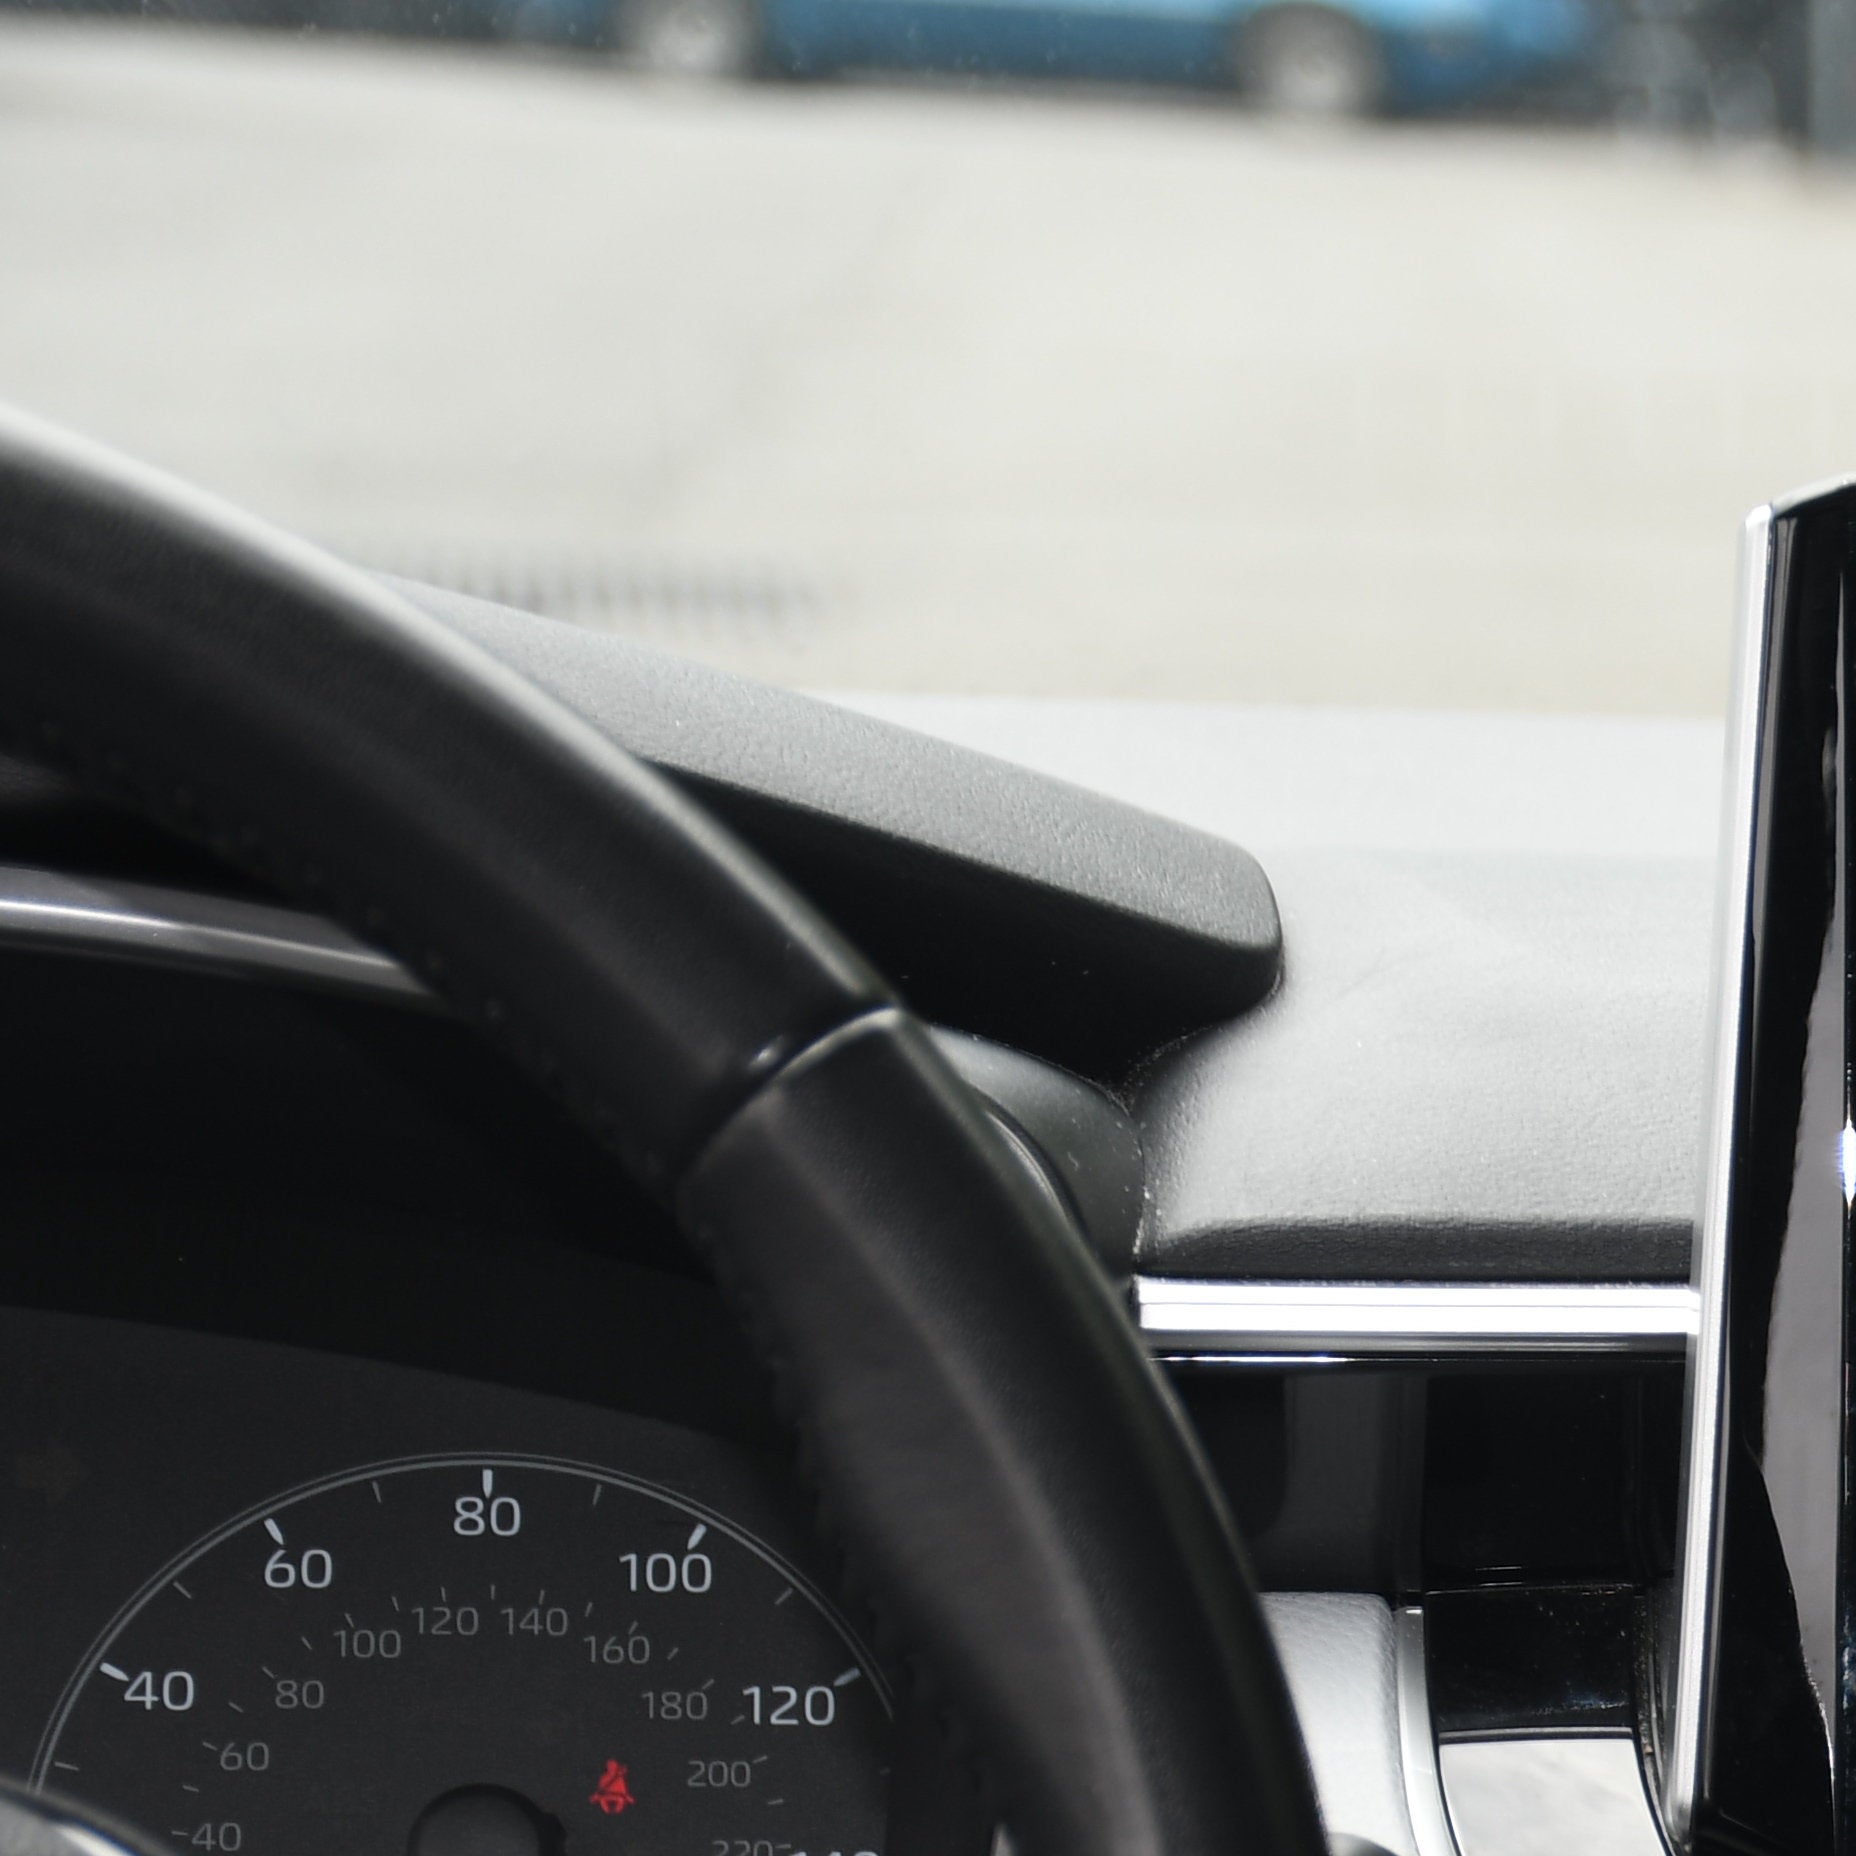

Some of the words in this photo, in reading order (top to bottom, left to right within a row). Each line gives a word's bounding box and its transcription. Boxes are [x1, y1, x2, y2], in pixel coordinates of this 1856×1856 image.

[452, 1496, 523, 1538] 80
[265, 1549, 332, 1588] 60
[618, 1551, 712, 1595] 100
[412, 1606, 479, 1636] 120
[500, 1605, 570, 1638] 140
[334, 1629, 401, 1658] 100
[582, 1633, 652, 1665] 160
[123, 1669, 196, 1713] 40
[274, 1679, 326, 1710] 80
[641, 1690, 709, 1722] 180
[742, 1684, 836, 1727] 120
[217, 1741, 271, 1772] 60
[686, 1759, 752, 1789] 200
[192, 1822, 242, 1851] 40
